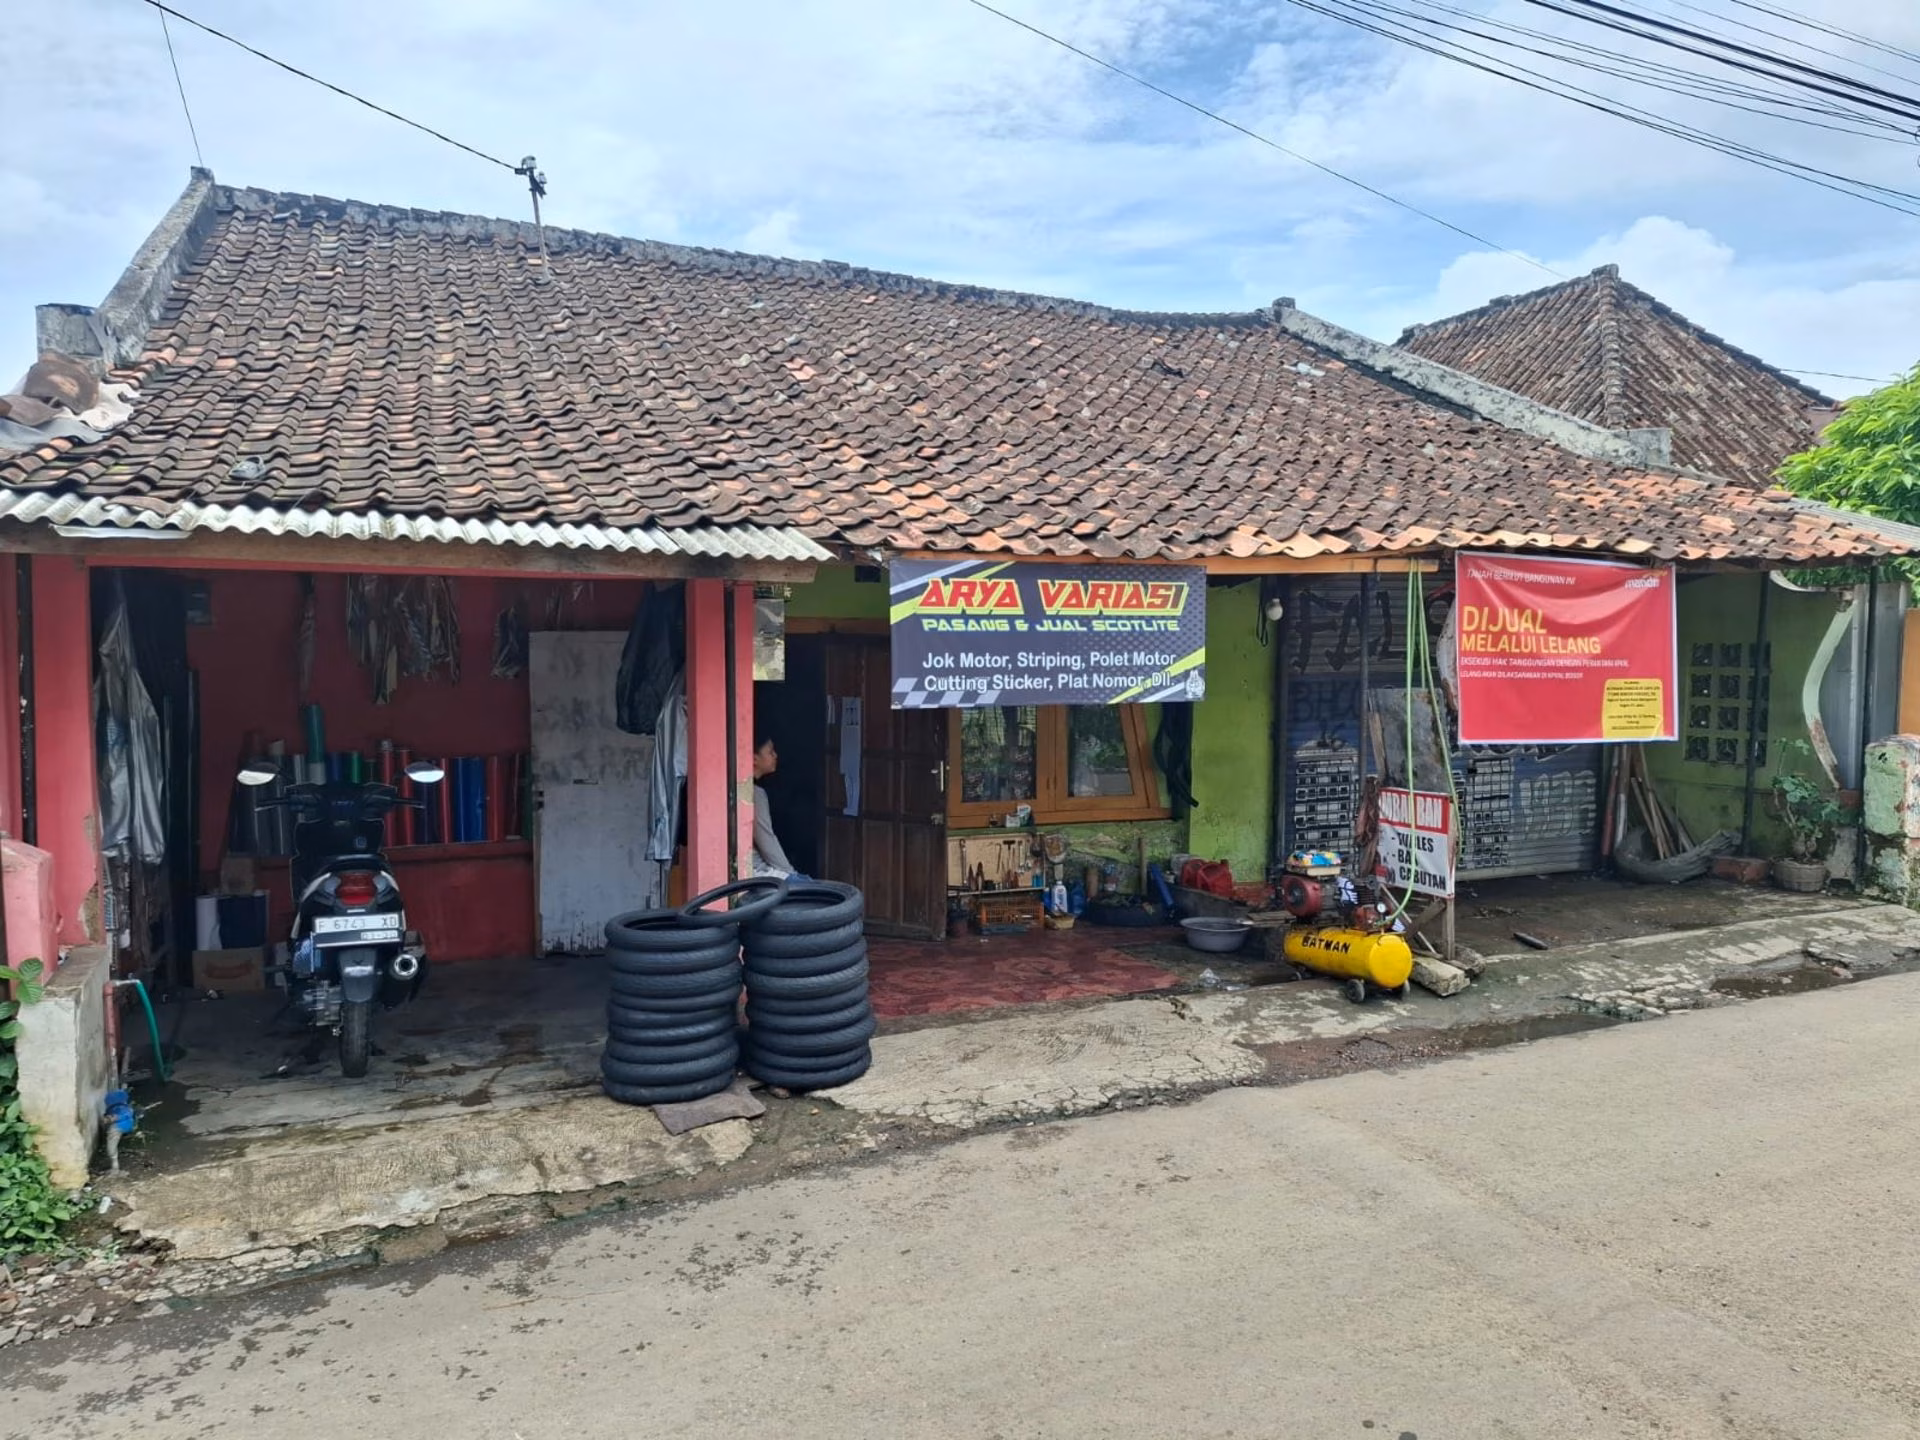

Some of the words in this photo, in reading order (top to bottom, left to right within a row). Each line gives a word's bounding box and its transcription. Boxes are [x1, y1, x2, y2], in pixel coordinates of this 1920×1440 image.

[1525, 573, 1565, 585] BANGUNAN
[914, 577, 1024, 614] ARYA
[1038, 579, 1189, 616] VARIASI
[922, 618, 1010, 632] PASANG
[1015, 619, 1029, 631] &
[1035, 619, 1087, 632] JUAL
[1093, 619, 1181, 632] SCOTLITE
[1462, 605, 1547, 634] DIJUAL
[1461, 634, 1537, 653] MELALUI
[1540, 635, 1602, 654] LELANG
[923, 652, 955, 669] Jok
[960, 652, 1013, 670] Motor,
[1017, 652, 1086, 671] Striping,
[1090, 651, 1129, 667] Polet
[1132, 651, 1177, 666] Motor
[924, 675, 988, 693] Cutting
[993, 674, 1053, 691] Sticker,
[1058, 674, 1089, 690] Plat
[1416, 796, 1442, 829] BAN
[1301, 934, 1351, 954] BATMAN
